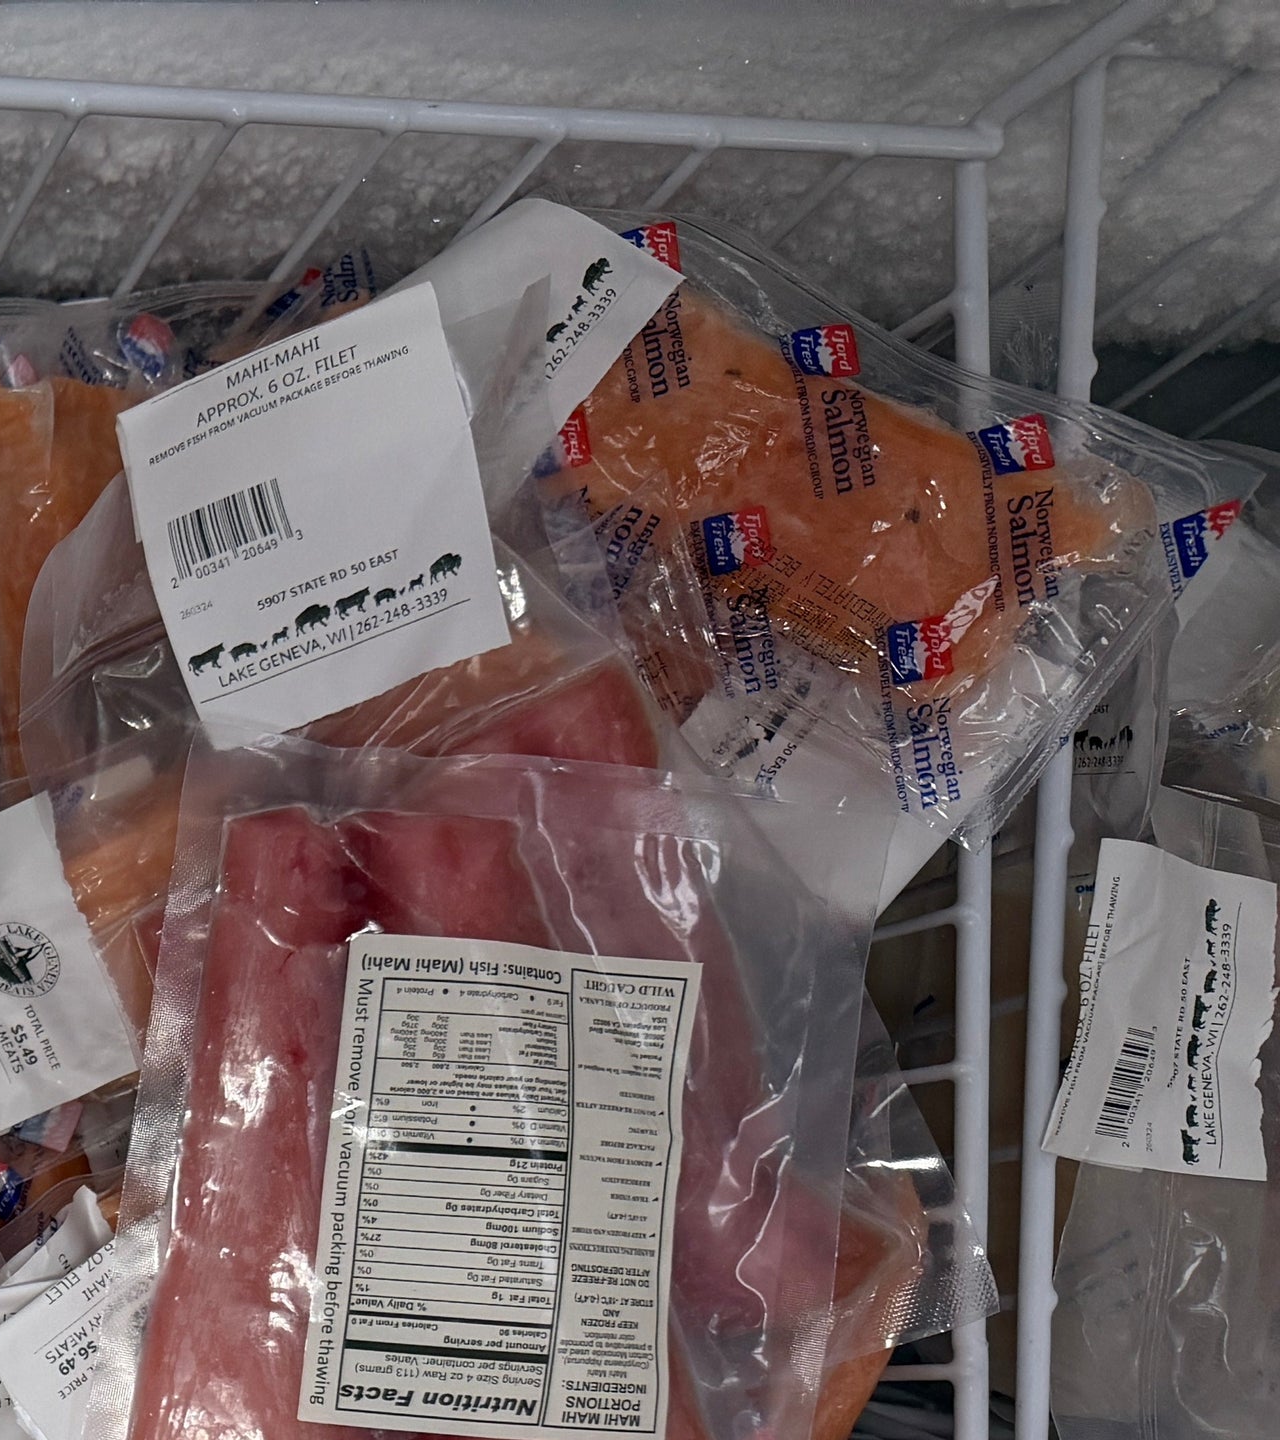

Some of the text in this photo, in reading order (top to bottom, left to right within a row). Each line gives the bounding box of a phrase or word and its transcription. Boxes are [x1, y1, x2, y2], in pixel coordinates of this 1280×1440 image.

[225, 334, 321, 390] MAHI-MAHI
[543, 287, 617, 372] 262-248-3339
[830, 327, 855, 373] Fjord
[147, 343, 409, 467] REMOVE FISH FROM VACUUM PACKAGE BEFORE THAWING
[195, 343, 358, 429] APPROX. 6 OZ. FILET
[819, 388, 853, 495] Salmon
[842, 389, 876, 489] Norwegian
[1006, 494, 1038, 607] Salmon
[1034, 488, 1060, 600] Norwegian
[217, 586, 448, 688] LAKE GENEVA, WI 262-248-3339
[360, 952, 562, 985] Contains: Fish (Mahi Mahi)
[582, 978, 676, 998] WILD CAUGHT
[1216, 923, 1232, 1019] 262-248-3339
[9, 1022, 39, 1066] $5.49
[22, 1002, 61, 1070] TOTAL PRICE
[339, 1383, 538, 1417] Nutrition Facts
[560, 1378, 647, 1395] INGREDIENTS:
[560, 1409, 641, 1428] MAHI MAHI
[564, 1394, 641, 1412] PORTIONS
